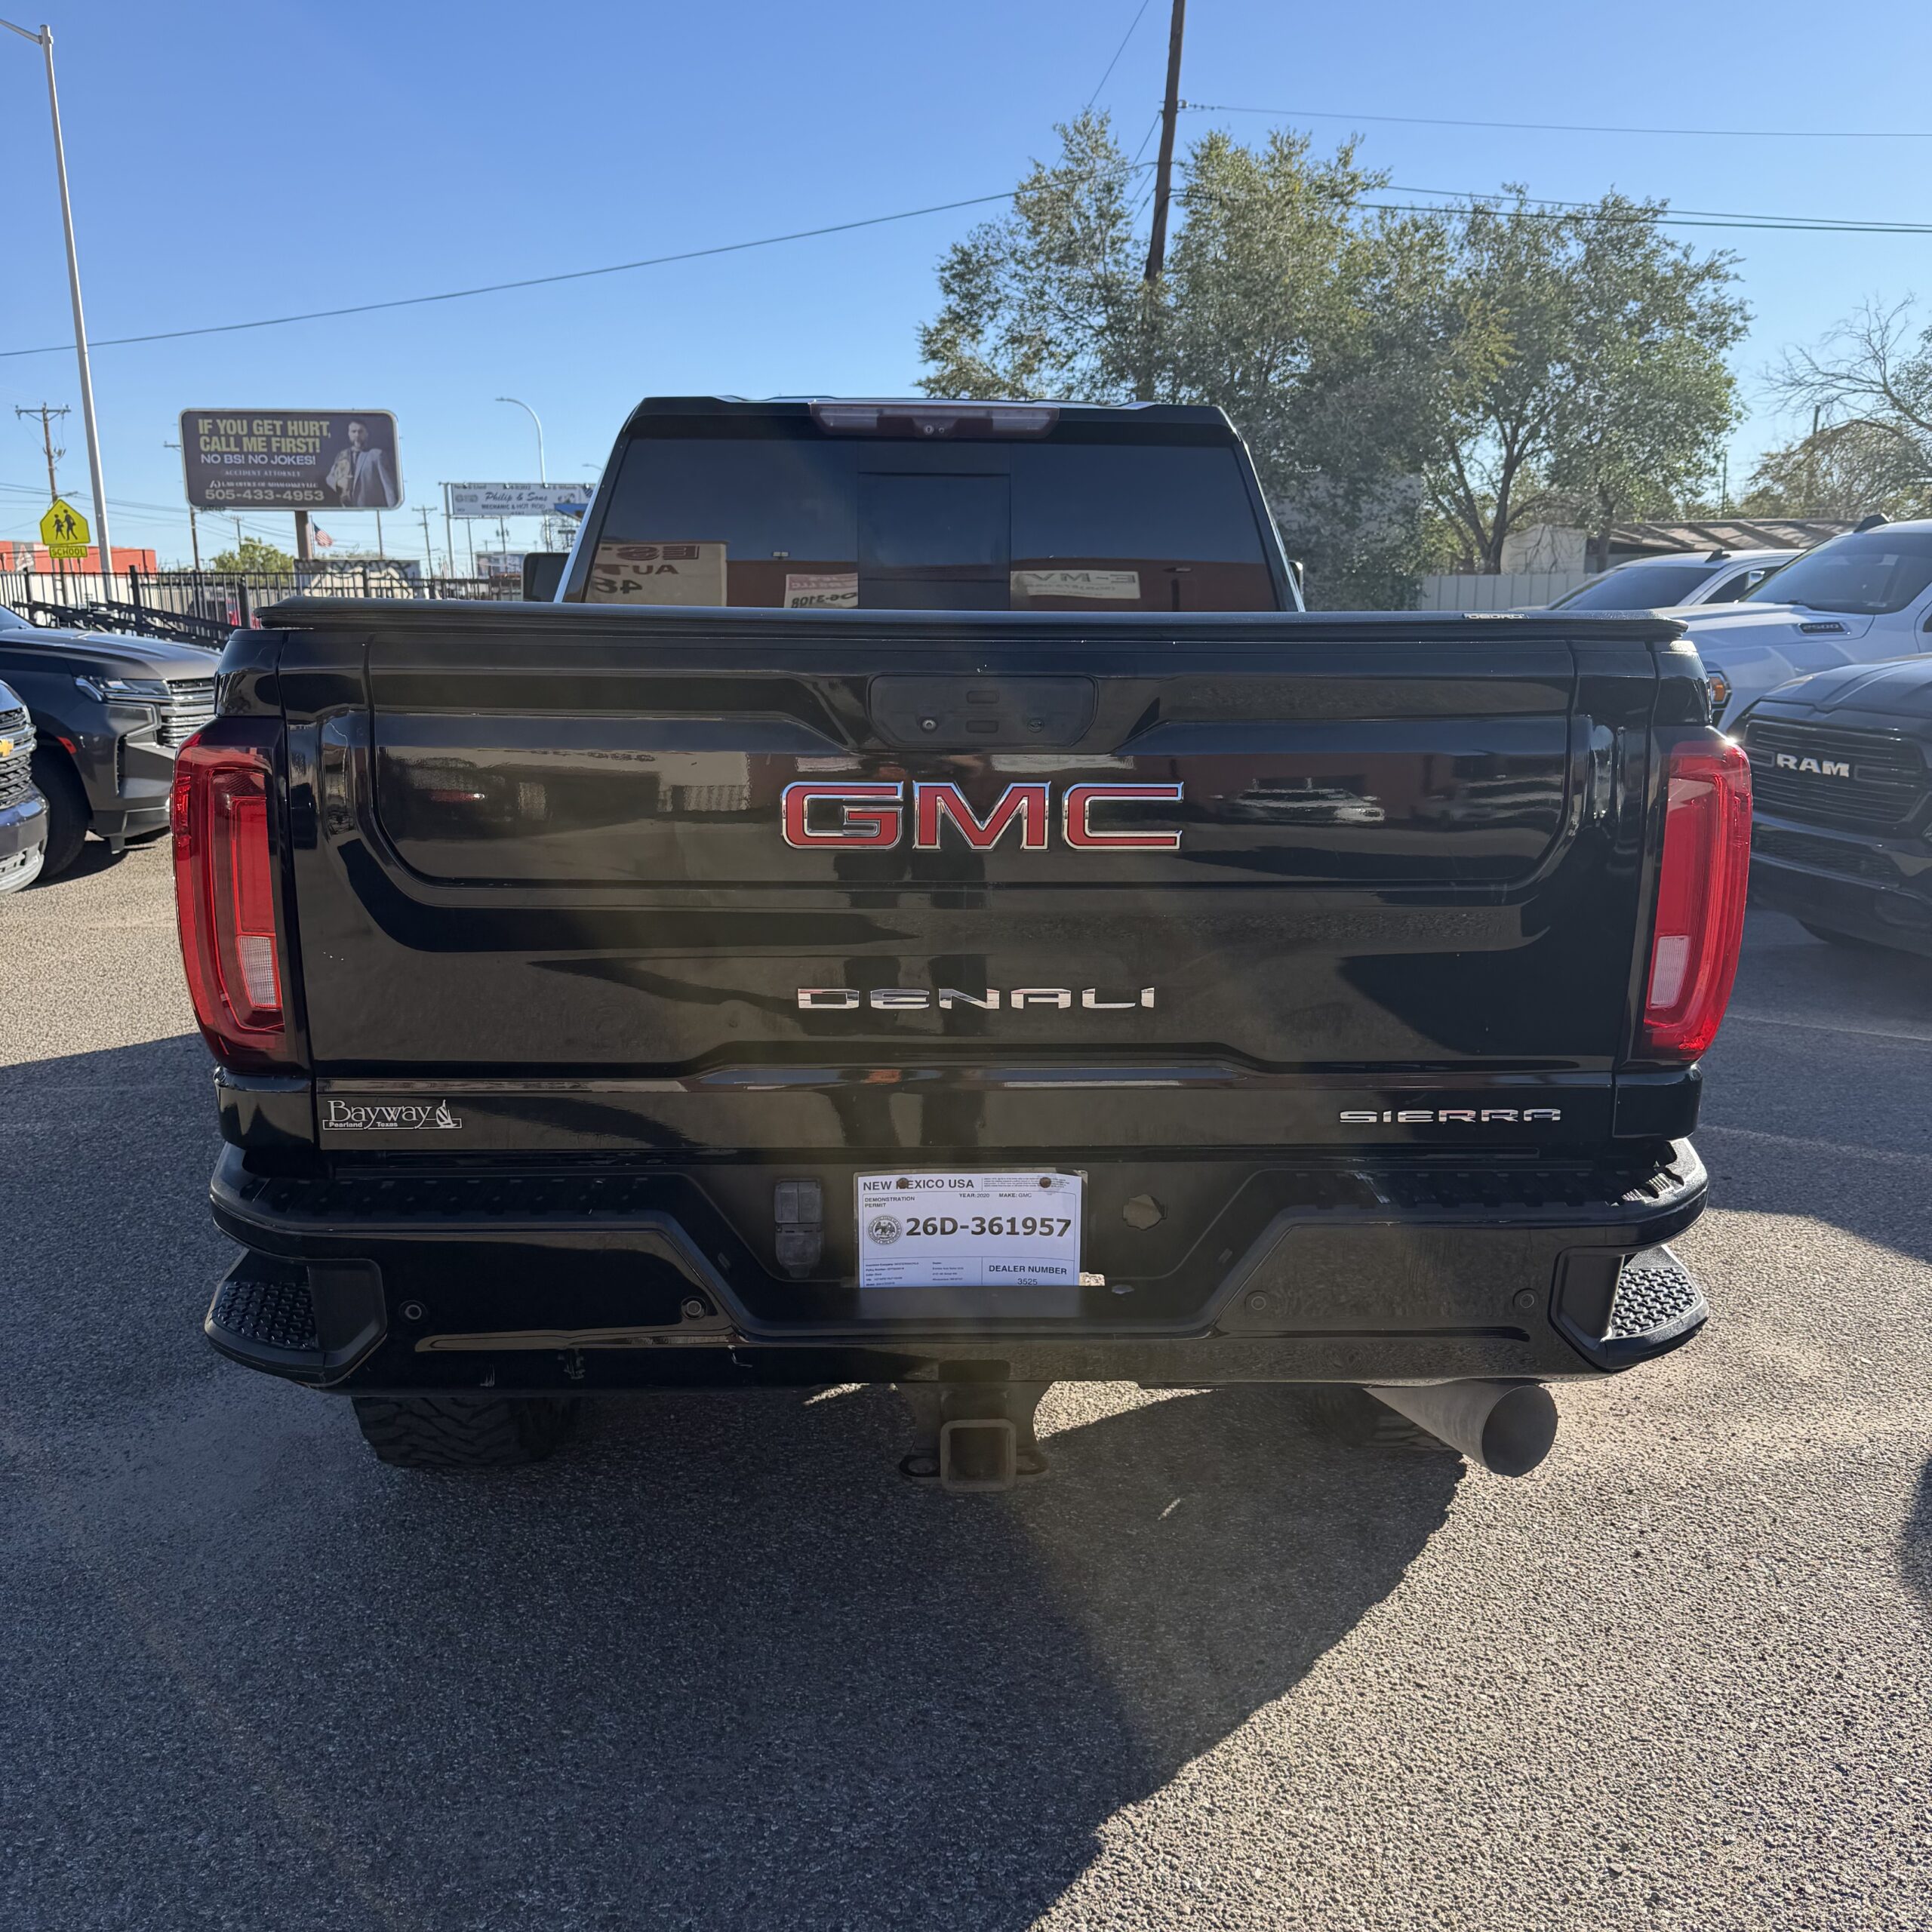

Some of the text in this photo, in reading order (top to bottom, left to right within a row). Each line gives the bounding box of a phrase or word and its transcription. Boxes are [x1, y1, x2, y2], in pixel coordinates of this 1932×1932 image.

[198, 419, 331, 438] IF YOU GET HURT,
[199, 435, 320, 453] CALL ME FIRST!
[201, 454, 316, 466] NO BS! NO JOKES!
[205, 489, 325, 501] 505-433-4953
[485, 491, 512, 503] Philip
[516, 493, 523, 501] &
[527, 492, 548, 502] Sons
[51, 548, 85, 556] SCHOOL
[1777, 752, 1850, 778] RAM
[781, 780, 1184, 851] GMC
[798, 987, 1155, 1010] DENALI
[327, 1100, 432, 1129] Bayway
[1340, 1109, 1561, 1123] SIERRA
[863, 1181, 892, 1191] NEW
[949, 1179, 974, 1189] USA
[906, 1217, 1072, 1237] 26D-361957
[1028, 1266, 1067, 1275] NUMBER
